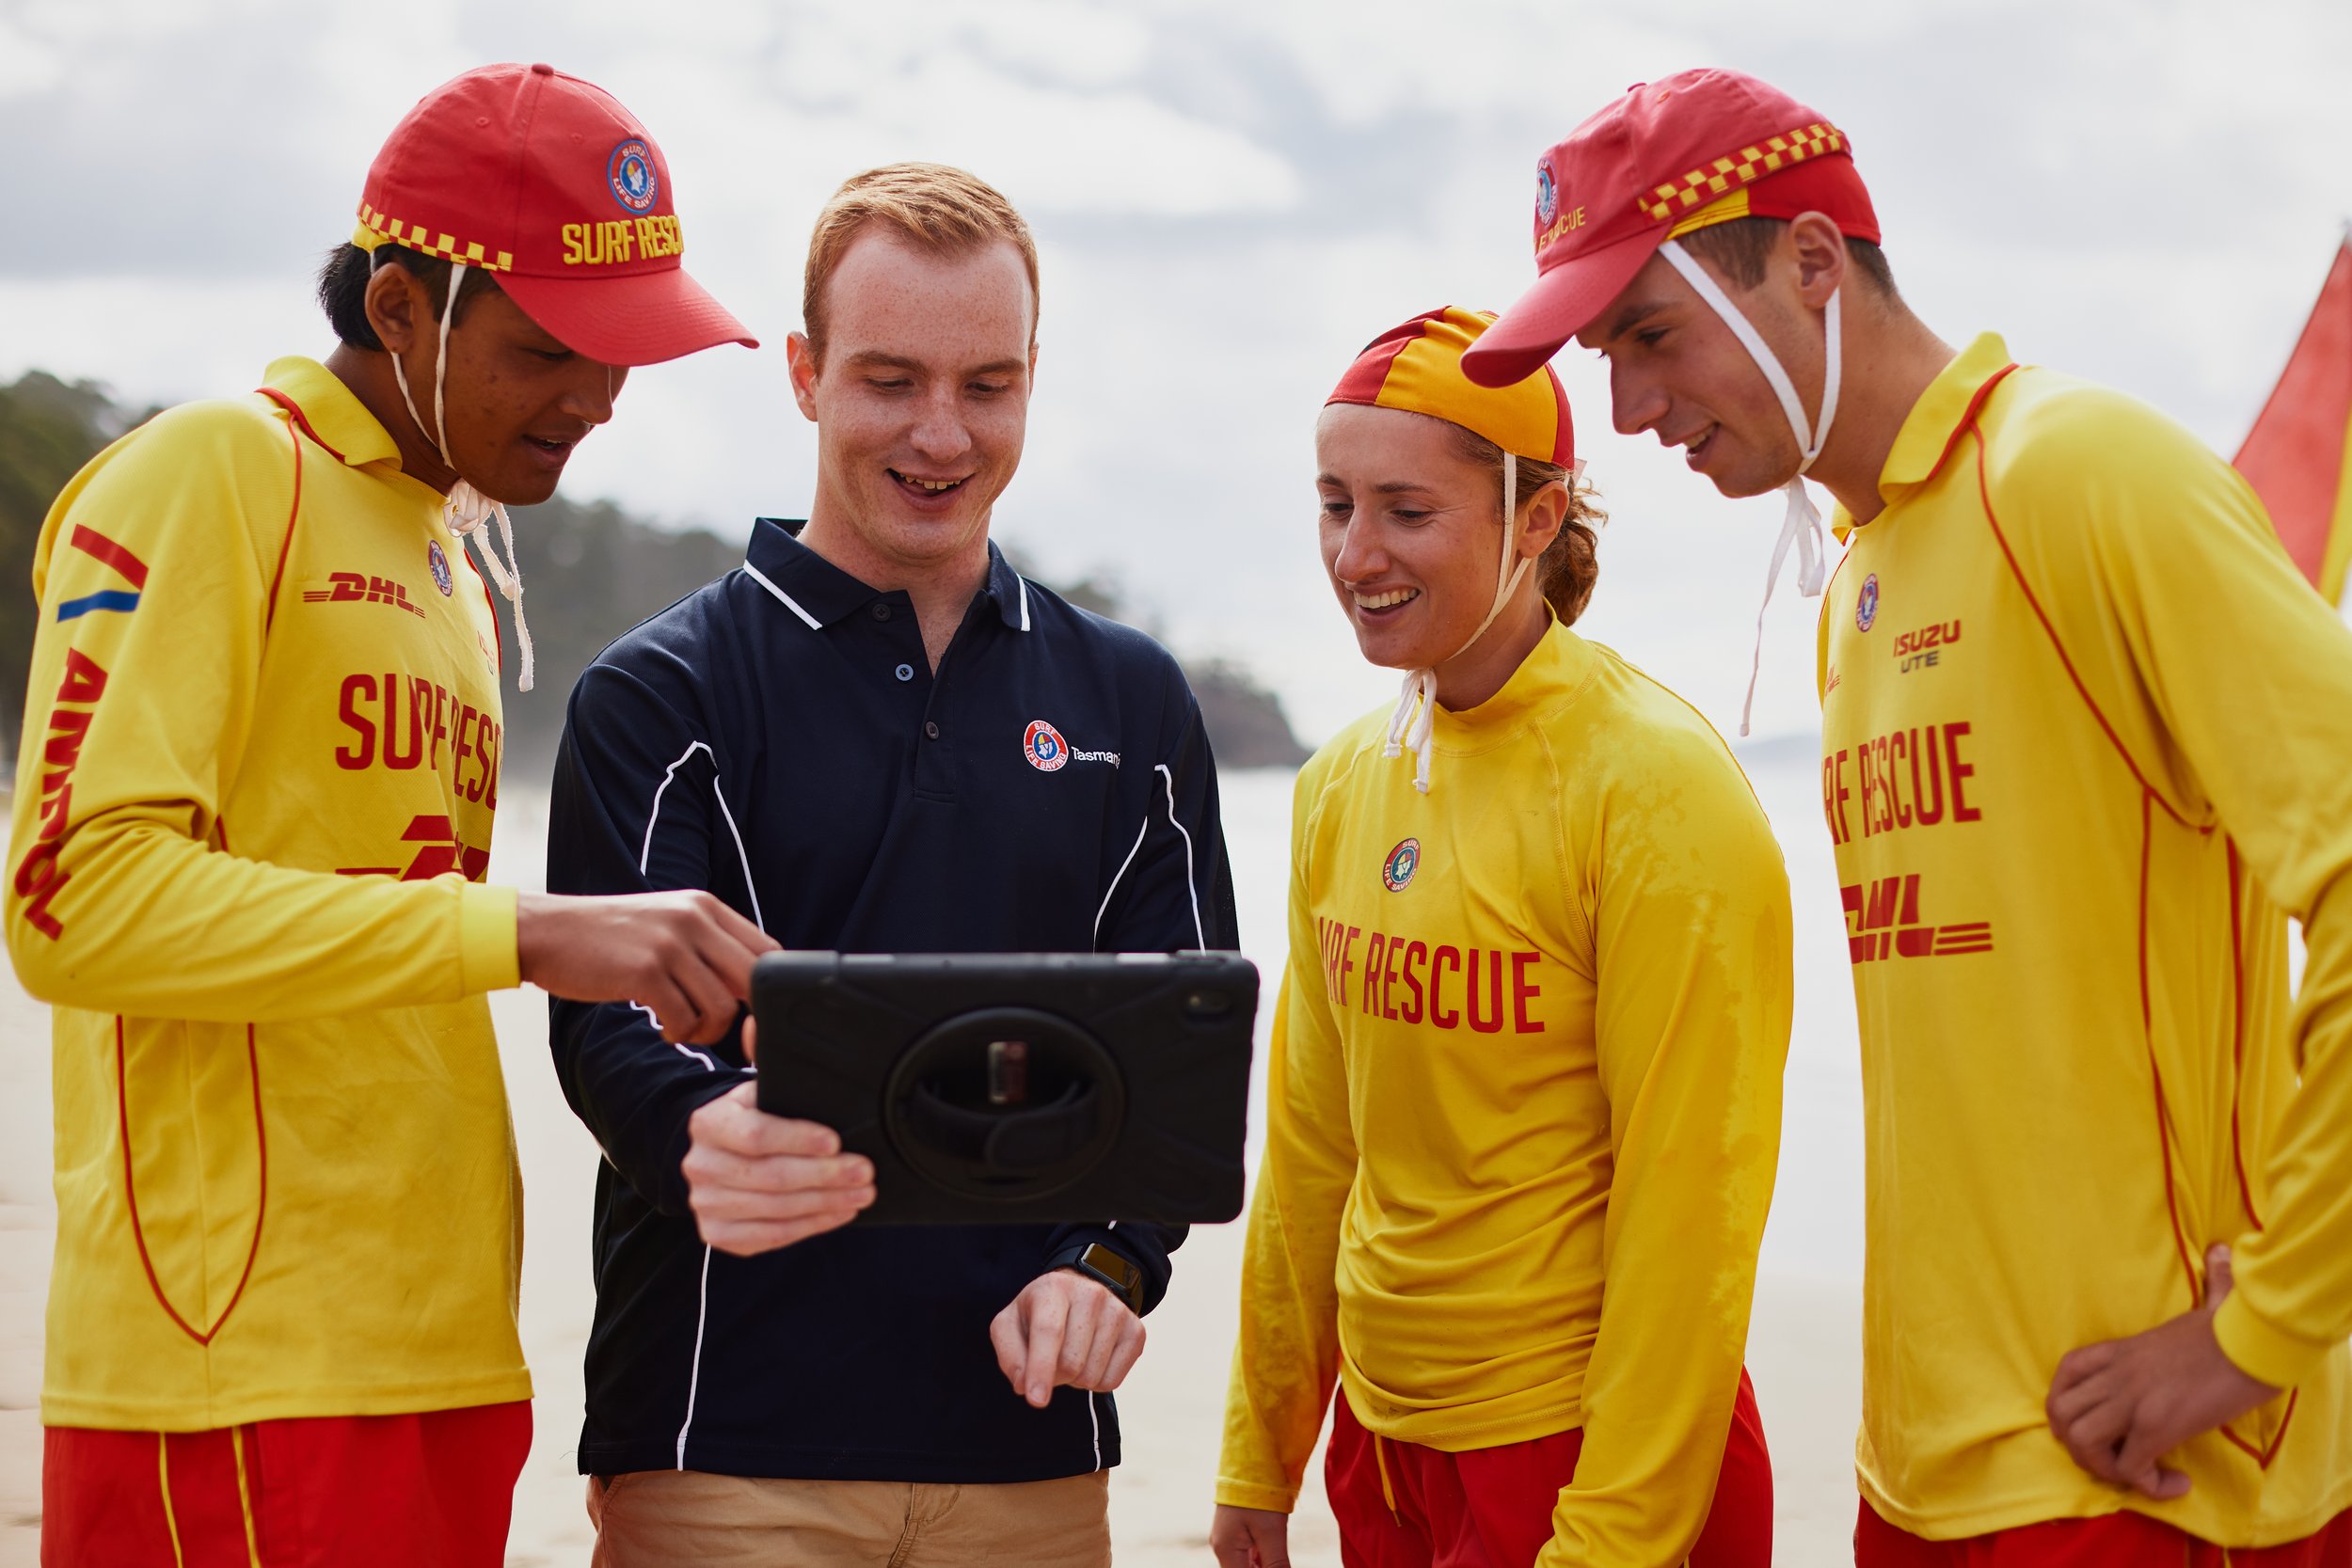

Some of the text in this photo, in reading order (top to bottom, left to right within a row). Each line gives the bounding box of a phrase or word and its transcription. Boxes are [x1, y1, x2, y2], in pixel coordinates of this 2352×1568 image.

[622, 146, 645, 158] SURF
[612, 177, 655, 208] LIFE SAVING
[562, 219, 635, 265] SURF
[328, 572, 415, 613] DHL
[1893, 620, 1961, 657] ISUZU
[1901, 650, 1940, 673] UTE
[1034, 722, 1057, 735] SURF
[1025, 745, 1066, 770] LIFE SAVING
[1858, 721, 1981, 838] RESCUE
[1402, 840, 1420, 850] SURF
[1384, 863, 1392, 886] LIFE
[1362, 931, 1545, 1034] RESCUE
